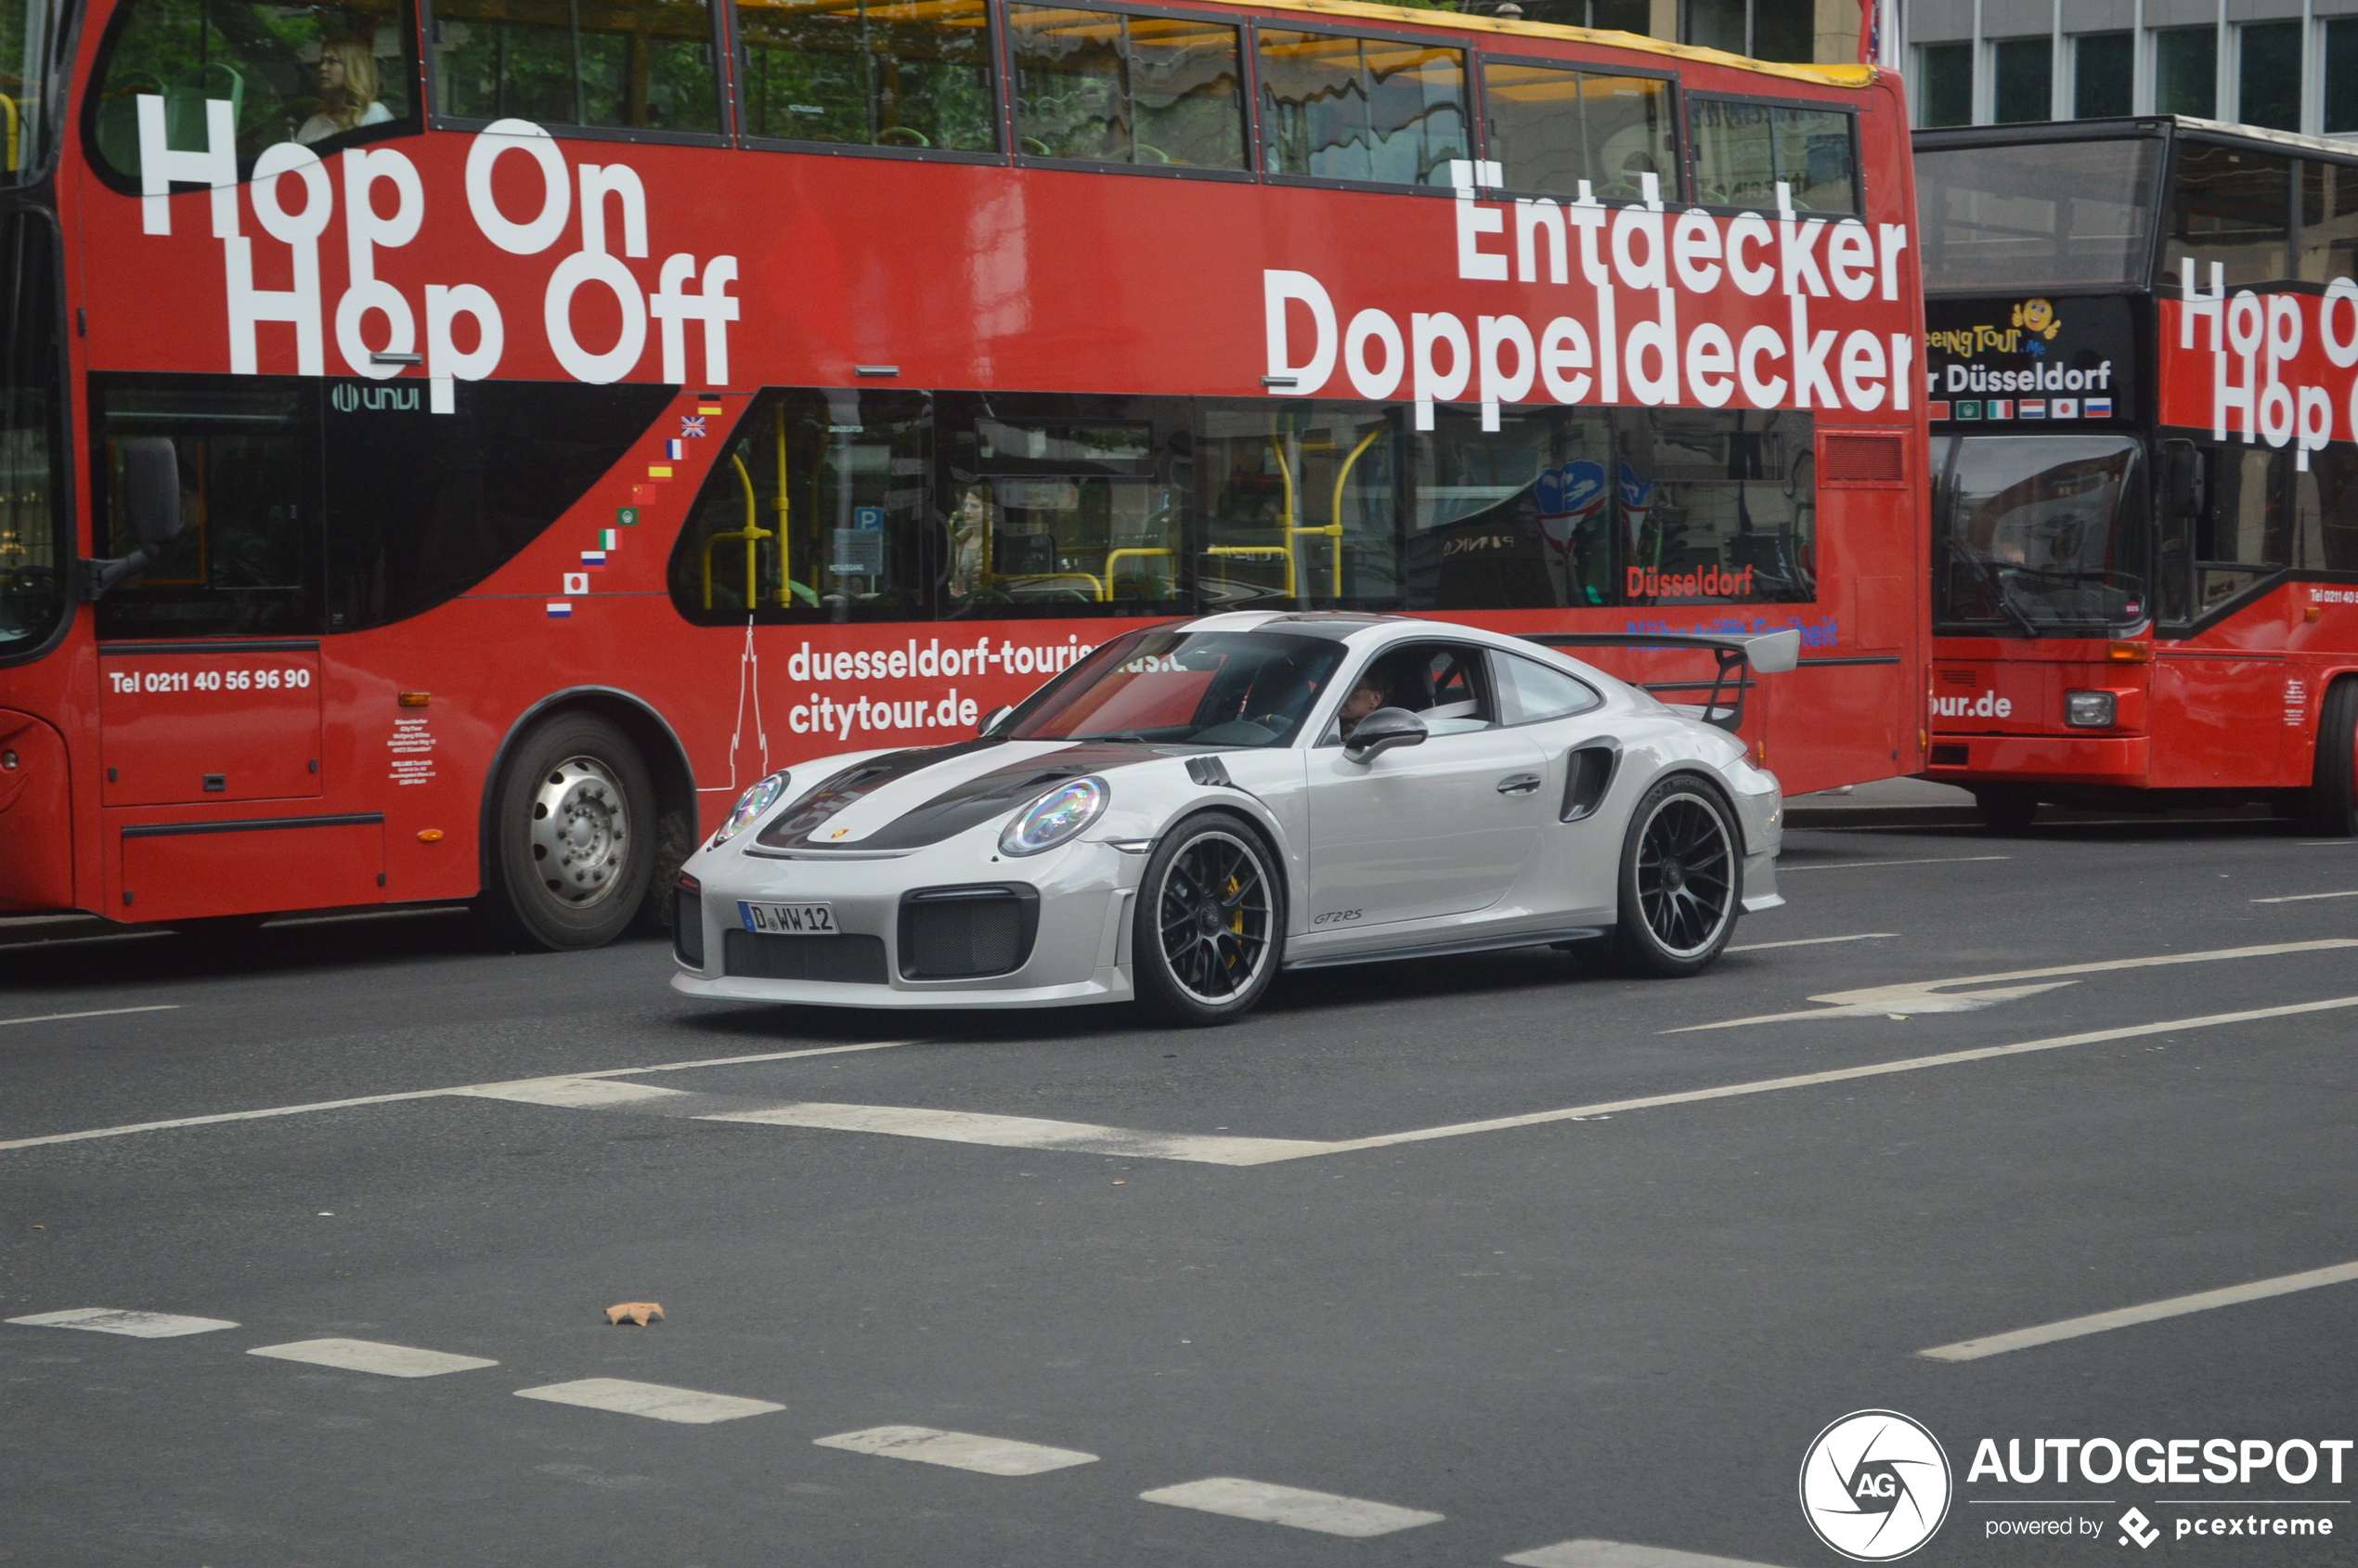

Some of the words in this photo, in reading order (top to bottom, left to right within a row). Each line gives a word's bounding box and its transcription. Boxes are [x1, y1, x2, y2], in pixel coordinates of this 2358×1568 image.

[136, 95, 424, 282] Hop
[465, 118, 649, 258] On
[1449, 160, 1907, 302] Entdecker
[225, 237, 504, 414] Hop
[544, 251, 739, 386] Off
[1263, 268, 1912, 432] Doppeldecker
[2181, 257, 2303, 382] Hop
[1947, 361, 2111, 393] Düsseldorf
[2214, 351, 2333, 472] Hop
[1626, 564, 1753, 597] Düsseldorf
[1753, 616, 1837, 646] Fheit
[110, 671, 140, 693] Tel
[145, 671, 189, 693] 0211
[193, 670, 221, 692] 40
[225, 669, 251, 691] 56
[254, 668, 280, 690] 96
[284, 668, 310, 689] 90
[788, 688, 978, 741] citytour.de
[750, 906, 767, 929] D
[804, 907, 834, 930] 12
